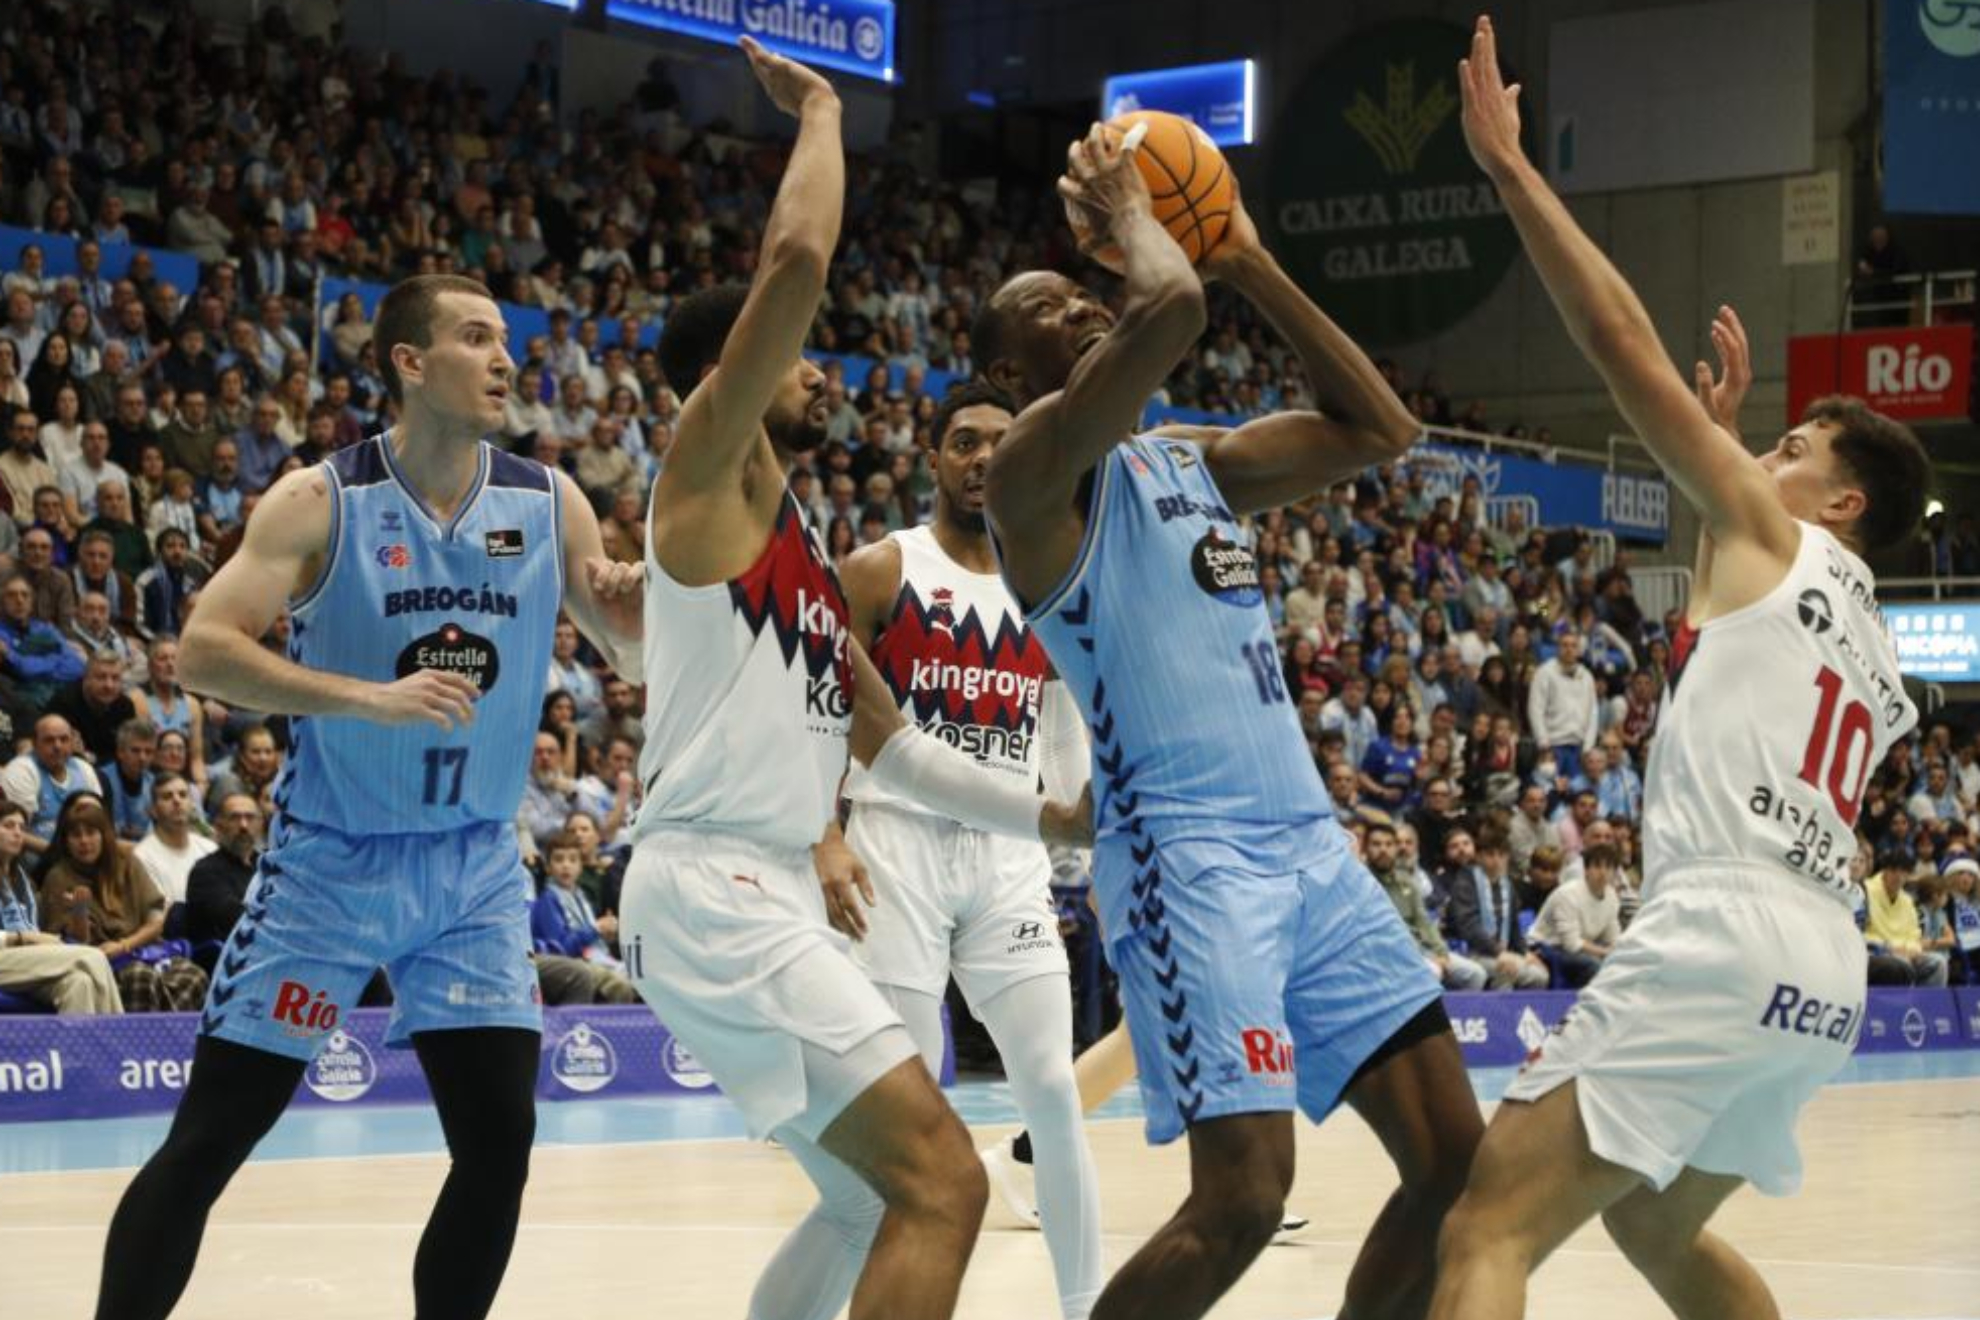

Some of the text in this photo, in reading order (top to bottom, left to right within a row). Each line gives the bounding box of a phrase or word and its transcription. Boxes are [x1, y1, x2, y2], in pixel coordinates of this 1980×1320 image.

[741, 0, 848, 53] Galicia
[1279, 182, 1510, 233] CAIXA RURA
[1324, 236, 1472, 278] GALEGA
[385, 582, 517, 617] BREOGÁN
[415, 646, 487, 666] Estrella
[1241, 639, 1285, 705] 18
[1797, 663, 1875, 830] 10
[422, 746, 469, 806] 17
[1760, 982, 1864, 1045] Recal
